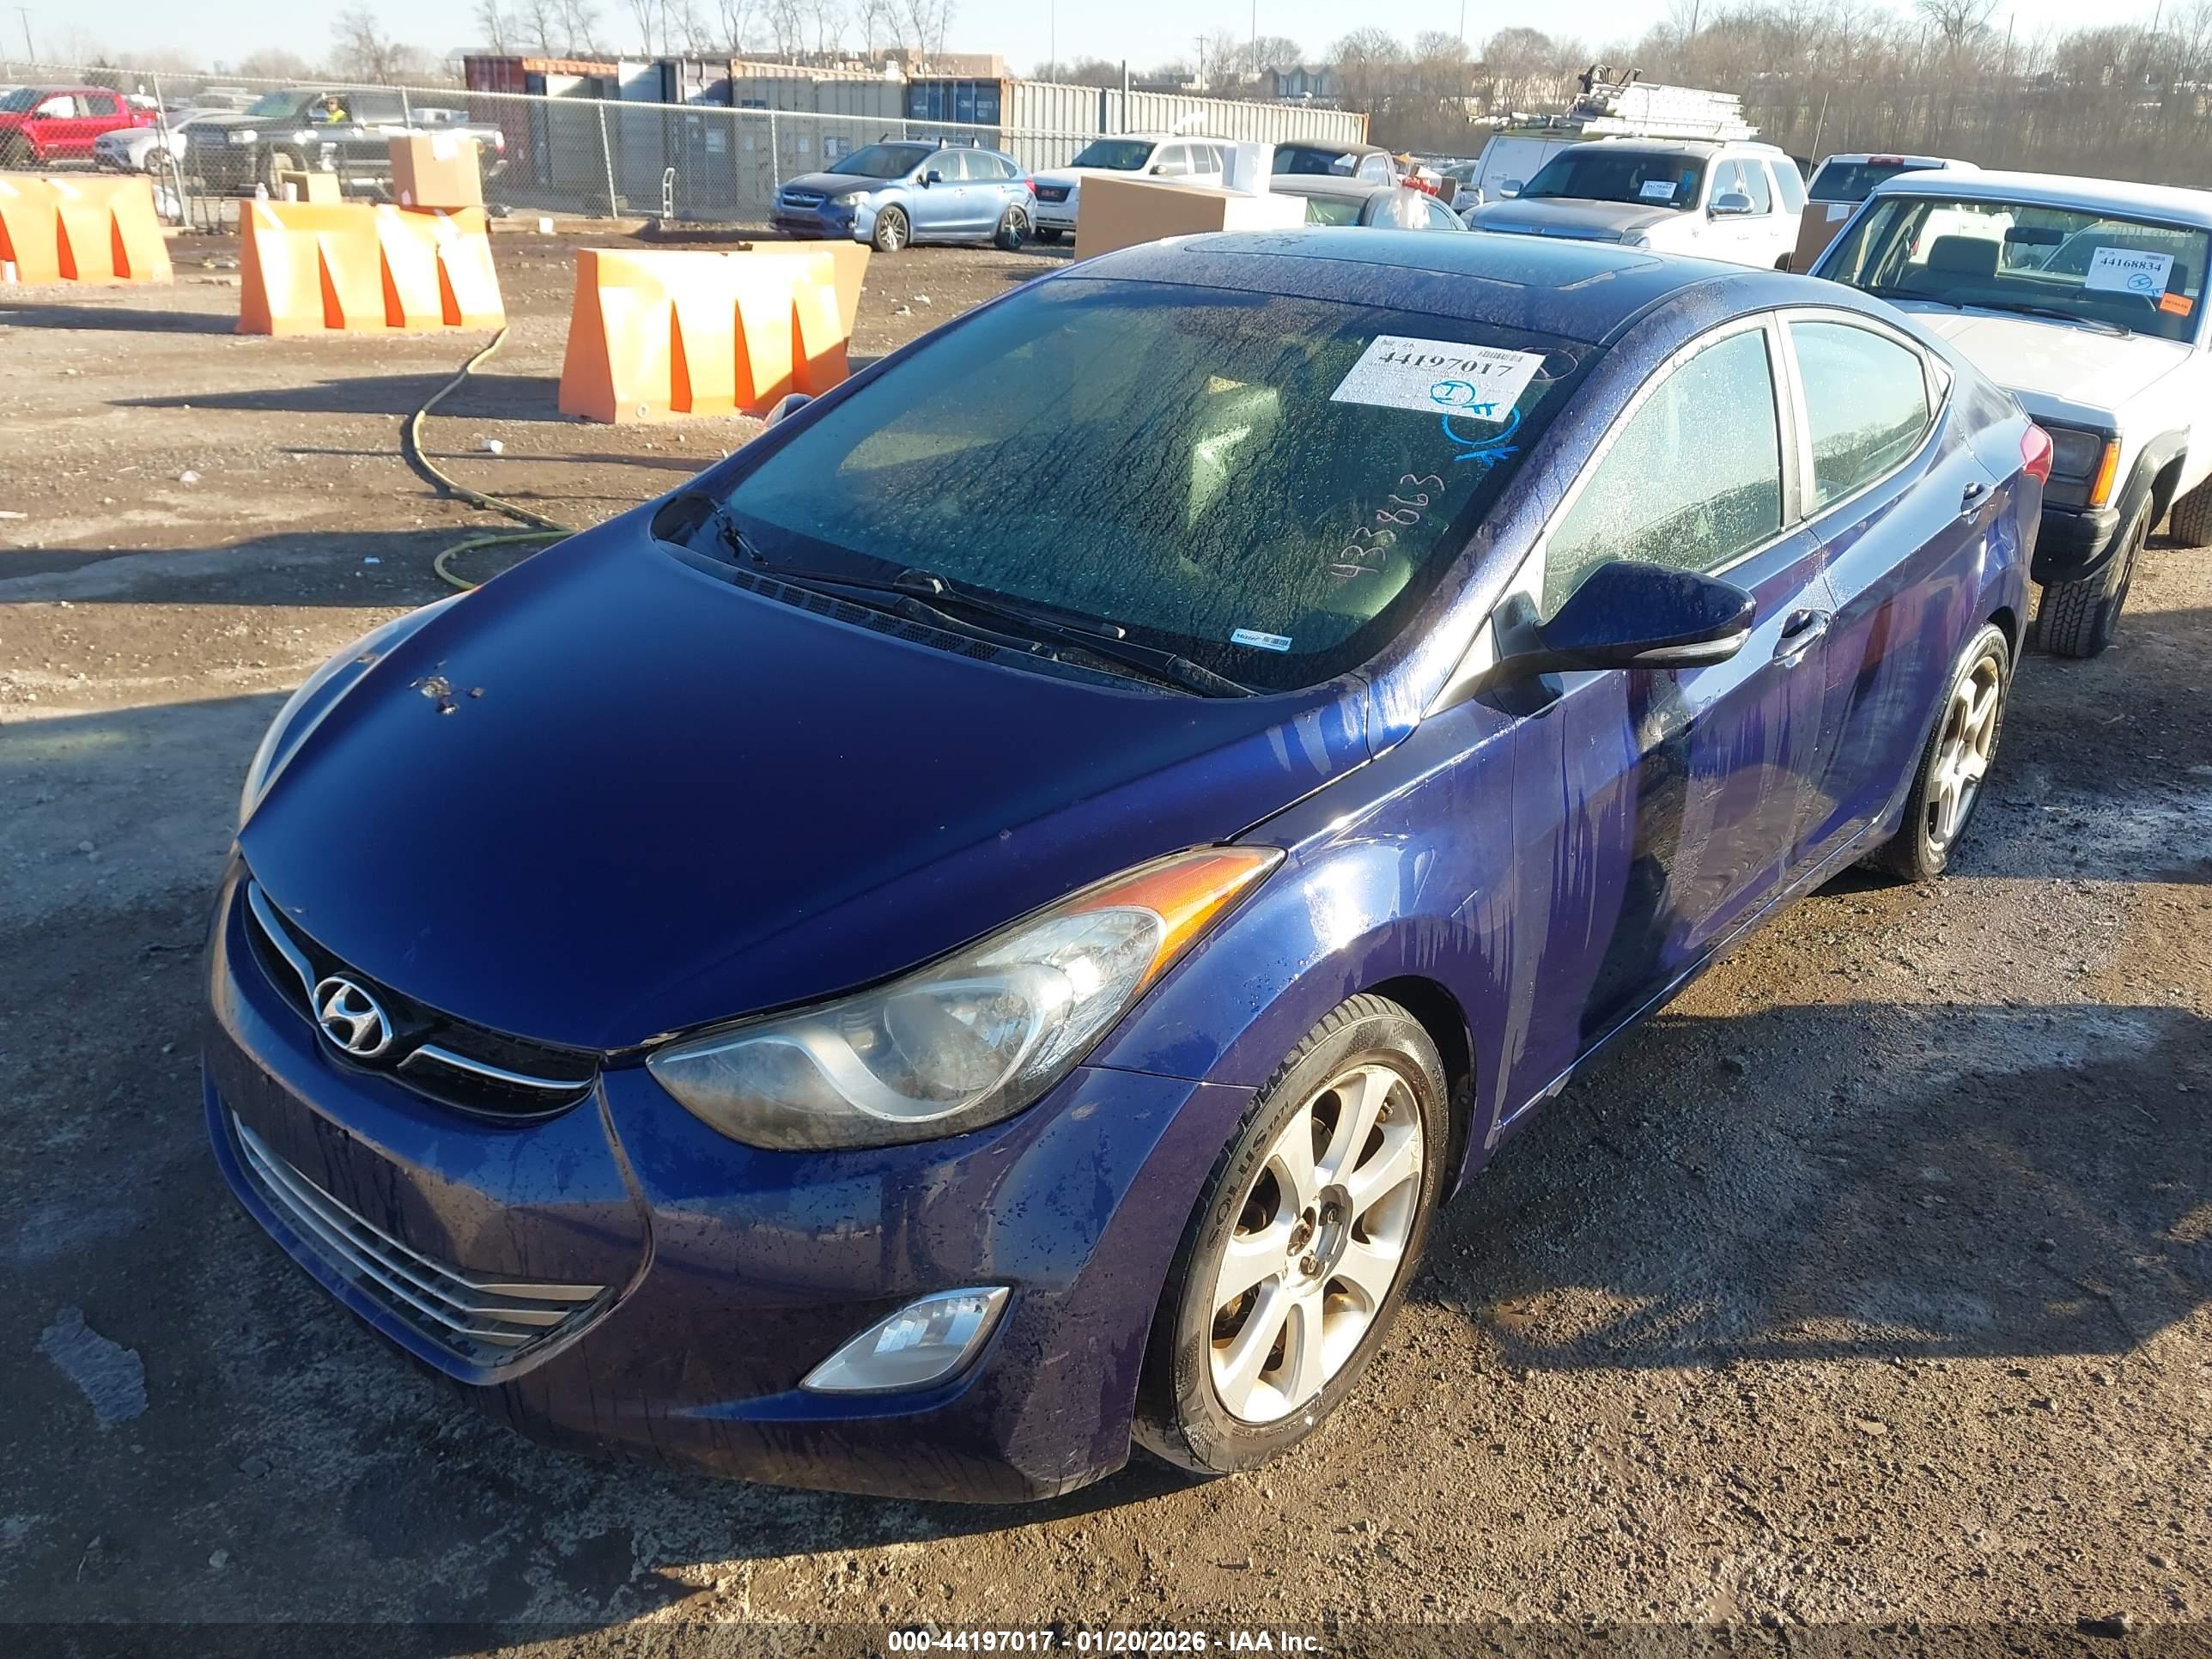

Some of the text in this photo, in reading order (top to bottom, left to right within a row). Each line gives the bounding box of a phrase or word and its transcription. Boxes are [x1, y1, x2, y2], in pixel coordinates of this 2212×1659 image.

[2099, 257, 2162, 272] 44168834
[1377, 350, 1515, 378] 44197017
[1330, 473, 1446, 578] 433863
[1206, 1098, 1290, 1251] SOLUS TA71
